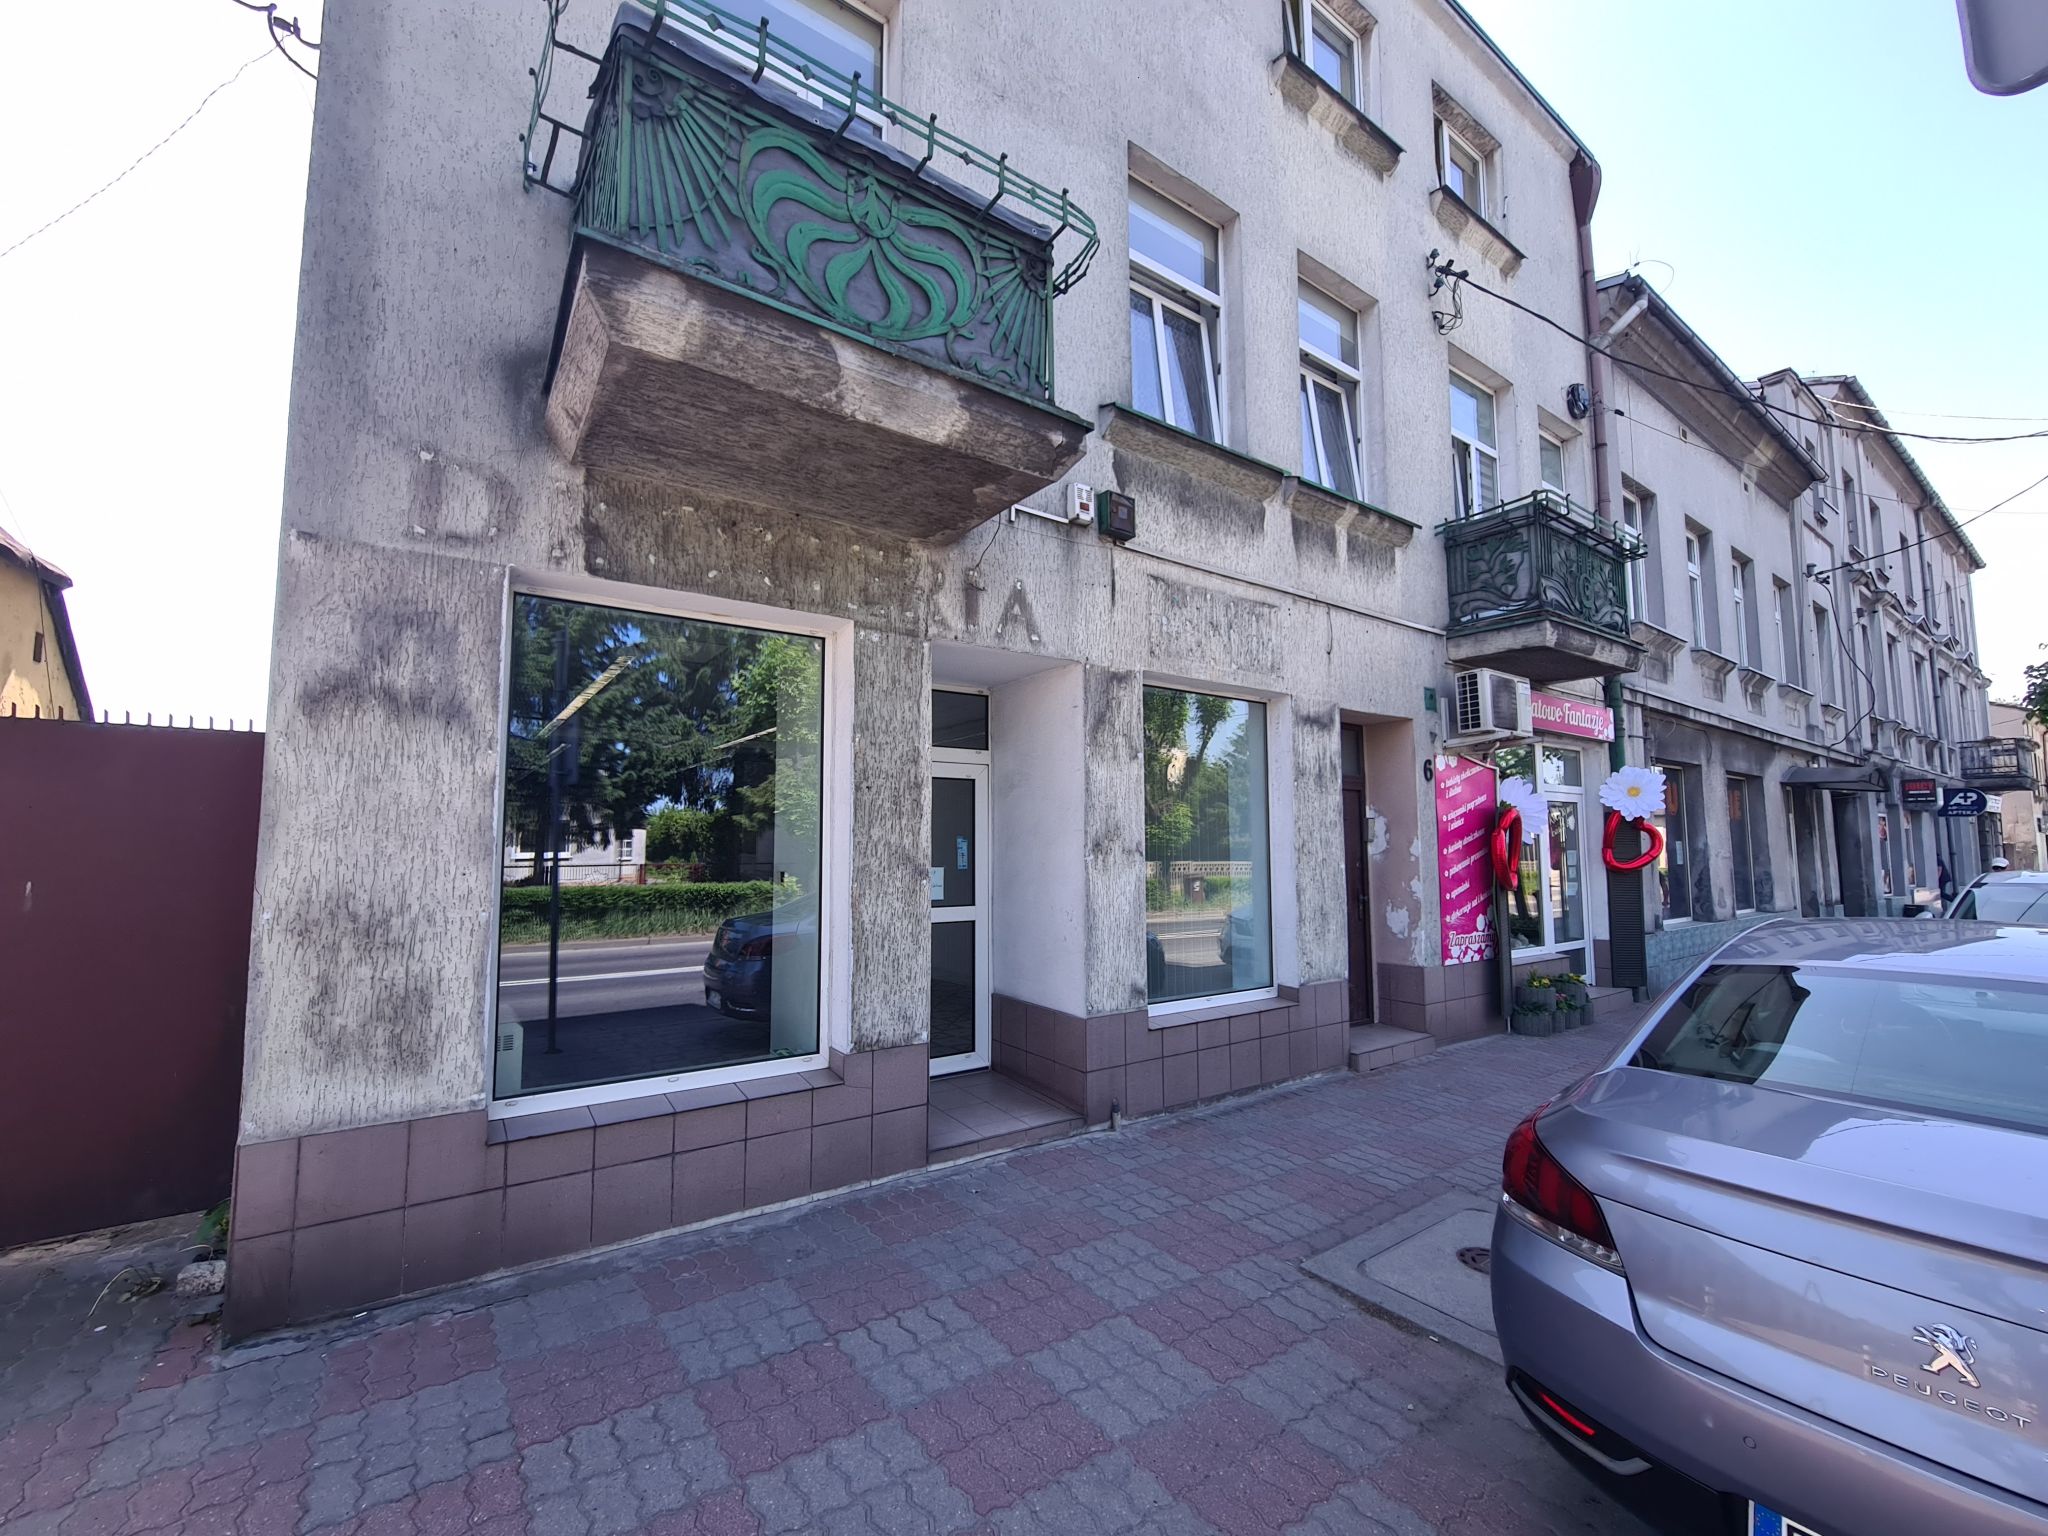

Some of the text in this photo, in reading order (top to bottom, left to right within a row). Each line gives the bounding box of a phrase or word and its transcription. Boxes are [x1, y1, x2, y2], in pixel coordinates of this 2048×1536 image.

[1531, 700, 1604, 735] atowe Fantazje
[1424, 759, 1433, 782] 6
[1871, 1366, 2031, 1429] PEUGEOT
